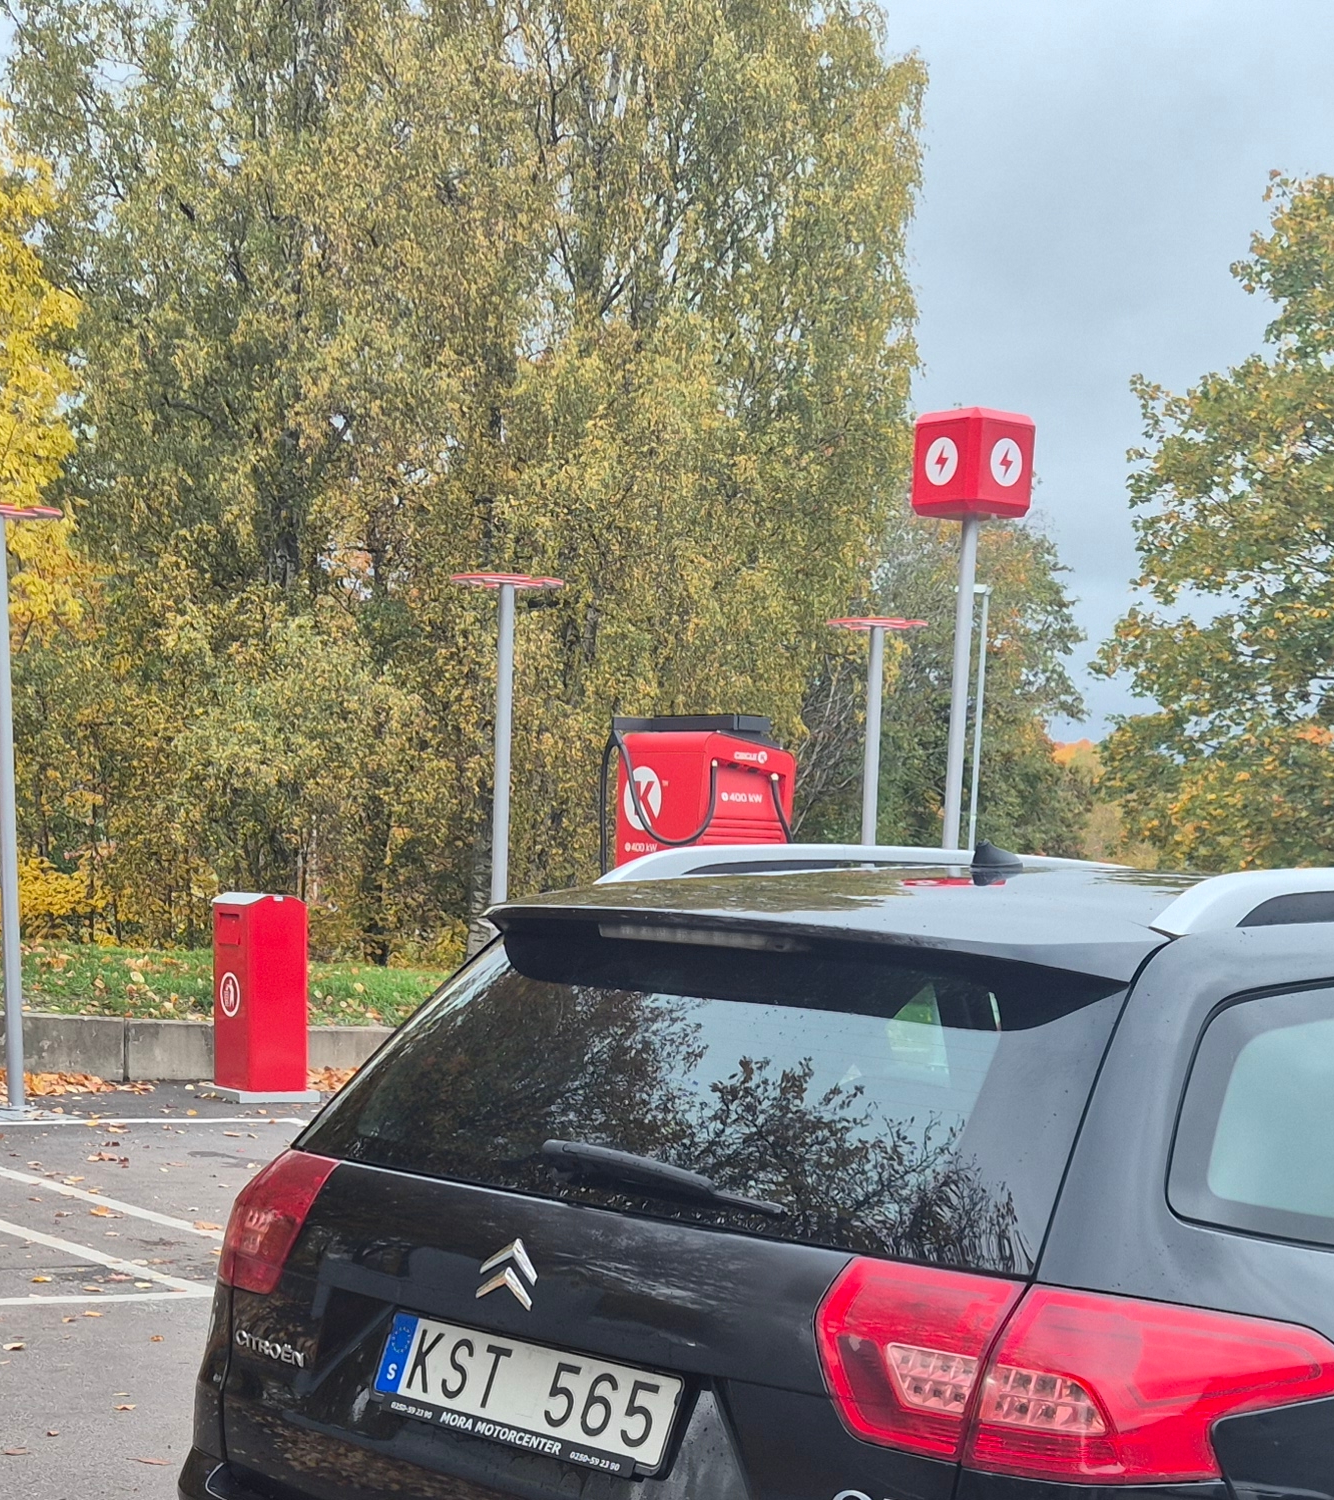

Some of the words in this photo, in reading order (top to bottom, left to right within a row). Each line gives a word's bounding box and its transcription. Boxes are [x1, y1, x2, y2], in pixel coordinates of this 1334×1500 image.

[730, 792, 748, 803] 400
[748, 793, 763, 803] kW
[235, 1329, 305, 1368] CITROËN
[385, 1362, 398, 1381] S
[406, 1328, 514, 1409] KST
[543, 1362, 660, 1448] 565
[439, 1411, 474, 1431] MORA
[474, 1421, 562, 1456] MOTORCENTER
